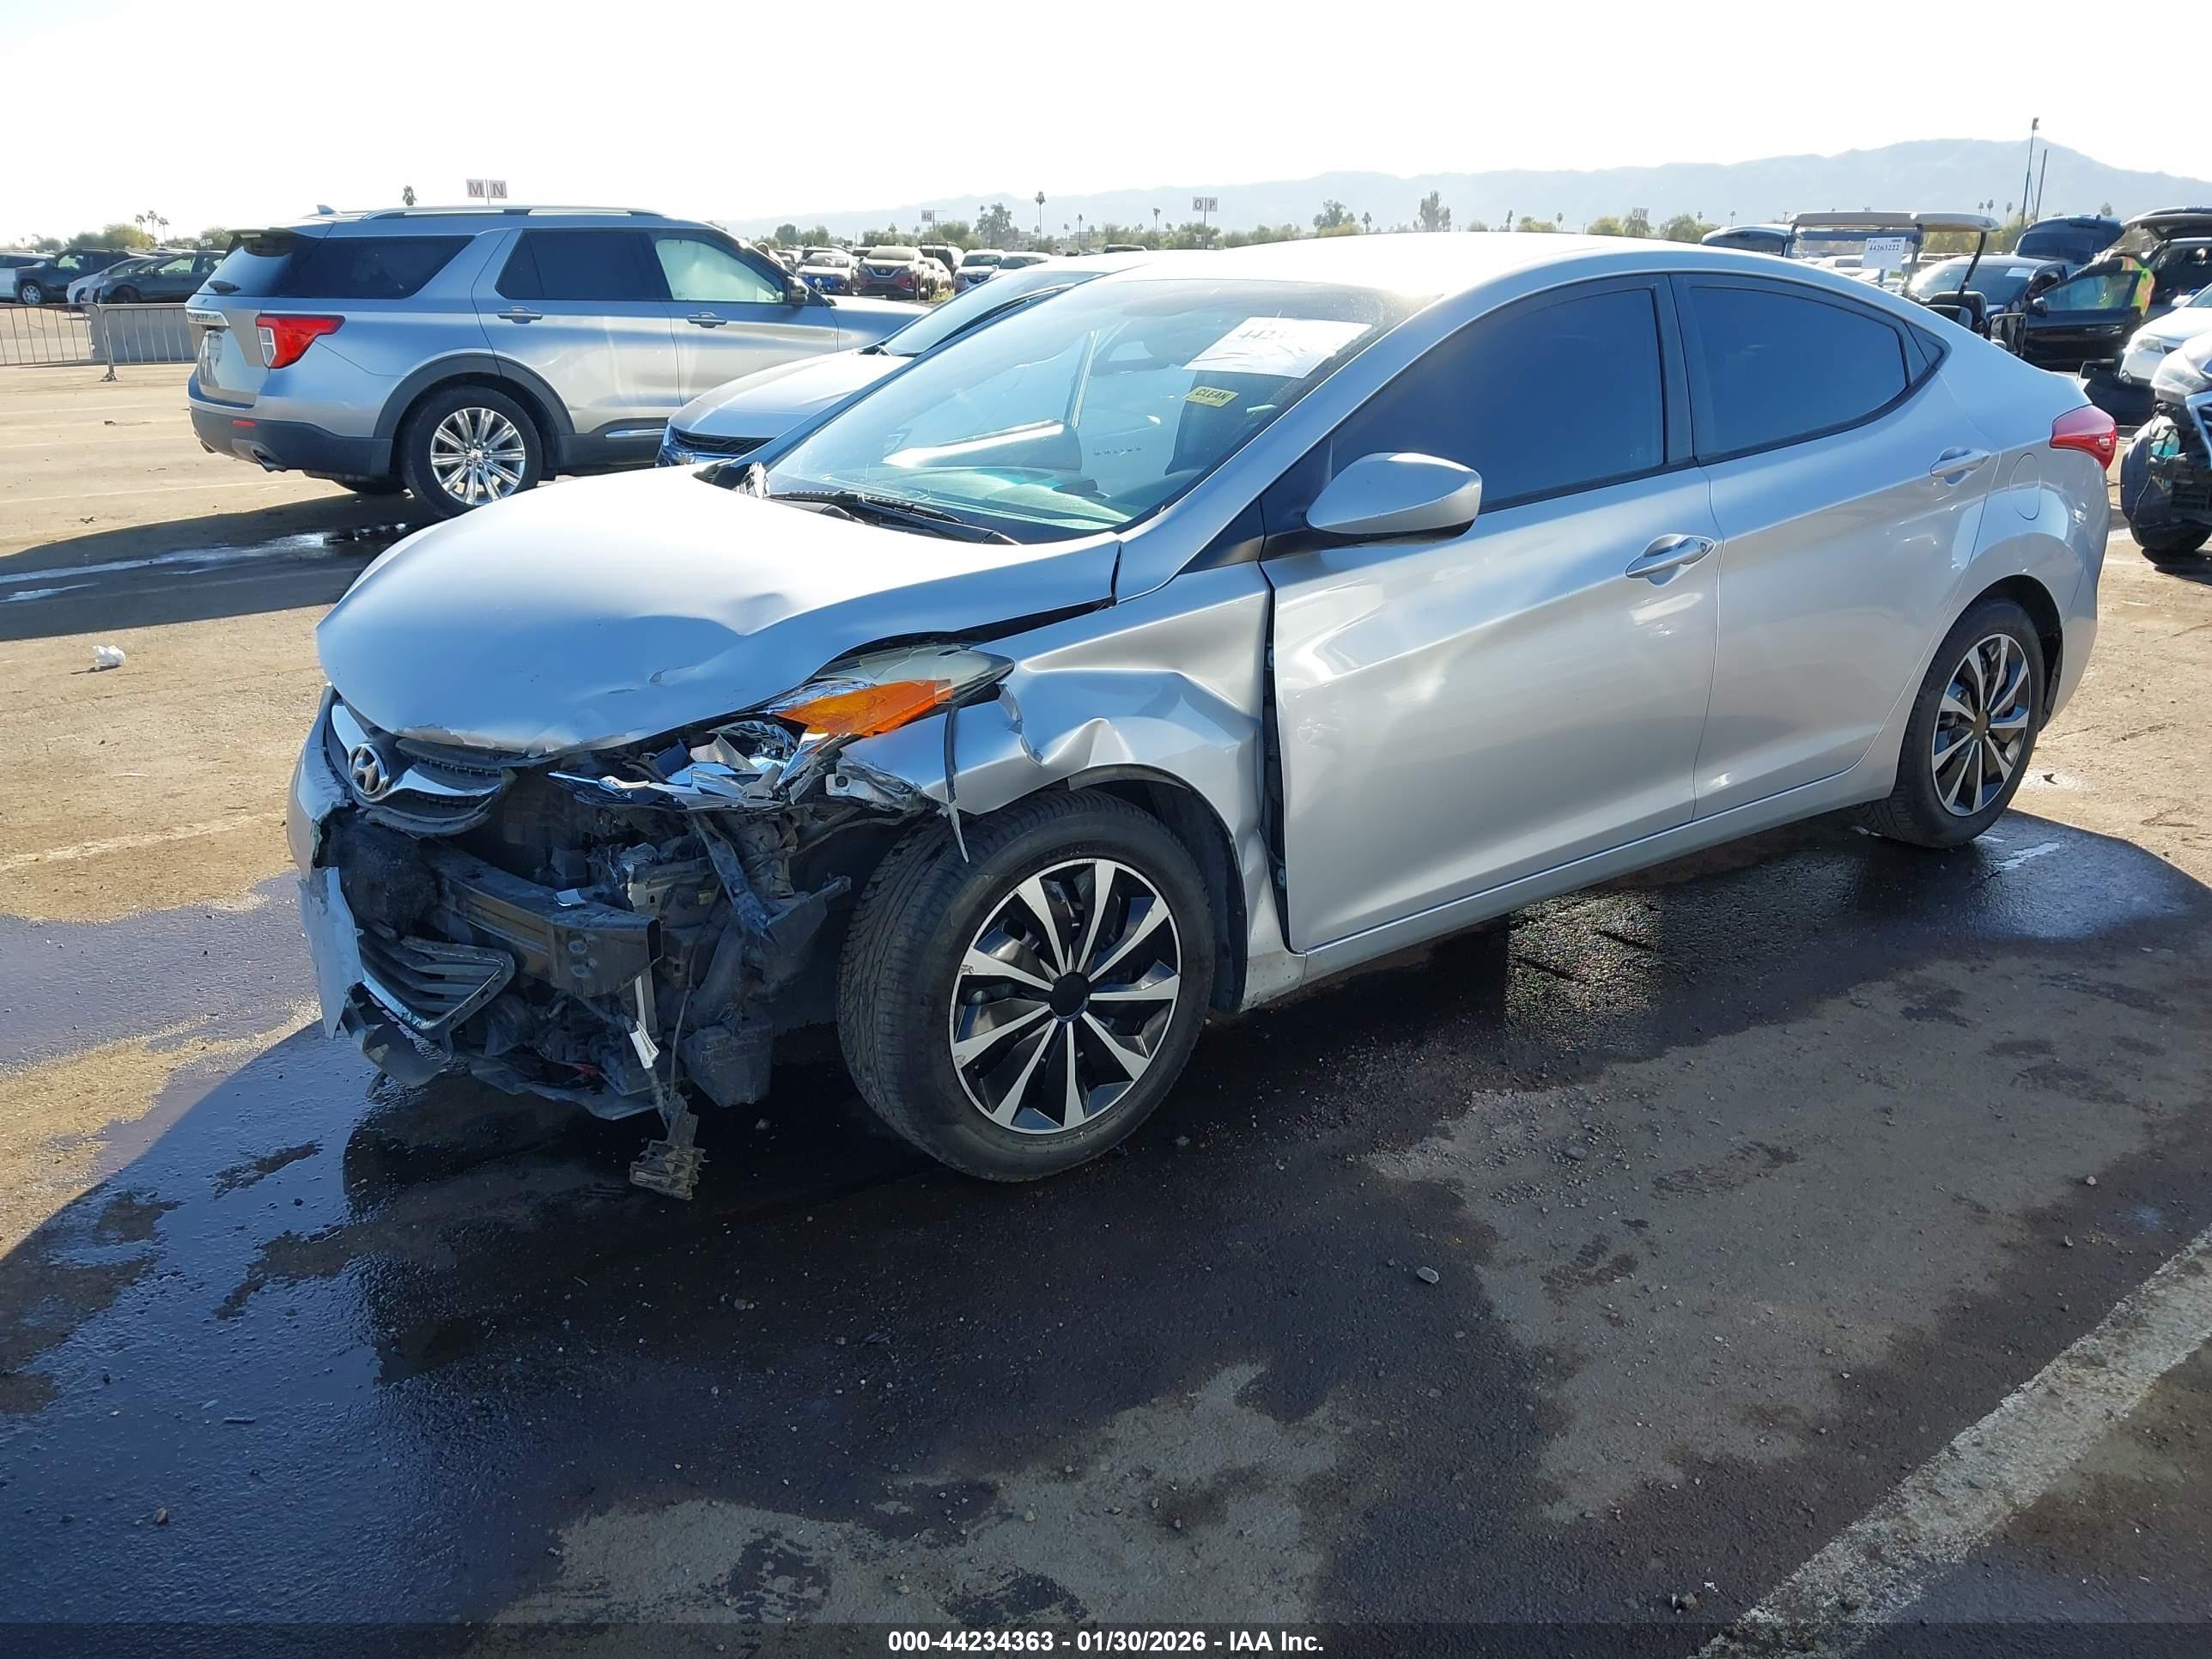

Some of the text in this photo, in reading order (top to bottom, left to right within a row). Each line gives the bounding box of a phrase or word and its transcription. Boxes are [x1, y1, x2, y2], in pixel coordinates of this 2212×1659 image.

[469, 182, 483, 195] M
[493, 183, 504, 196] N
[1209, 200, 1215, 211] P
[1195, 388, 1231, 400] CLEAN
